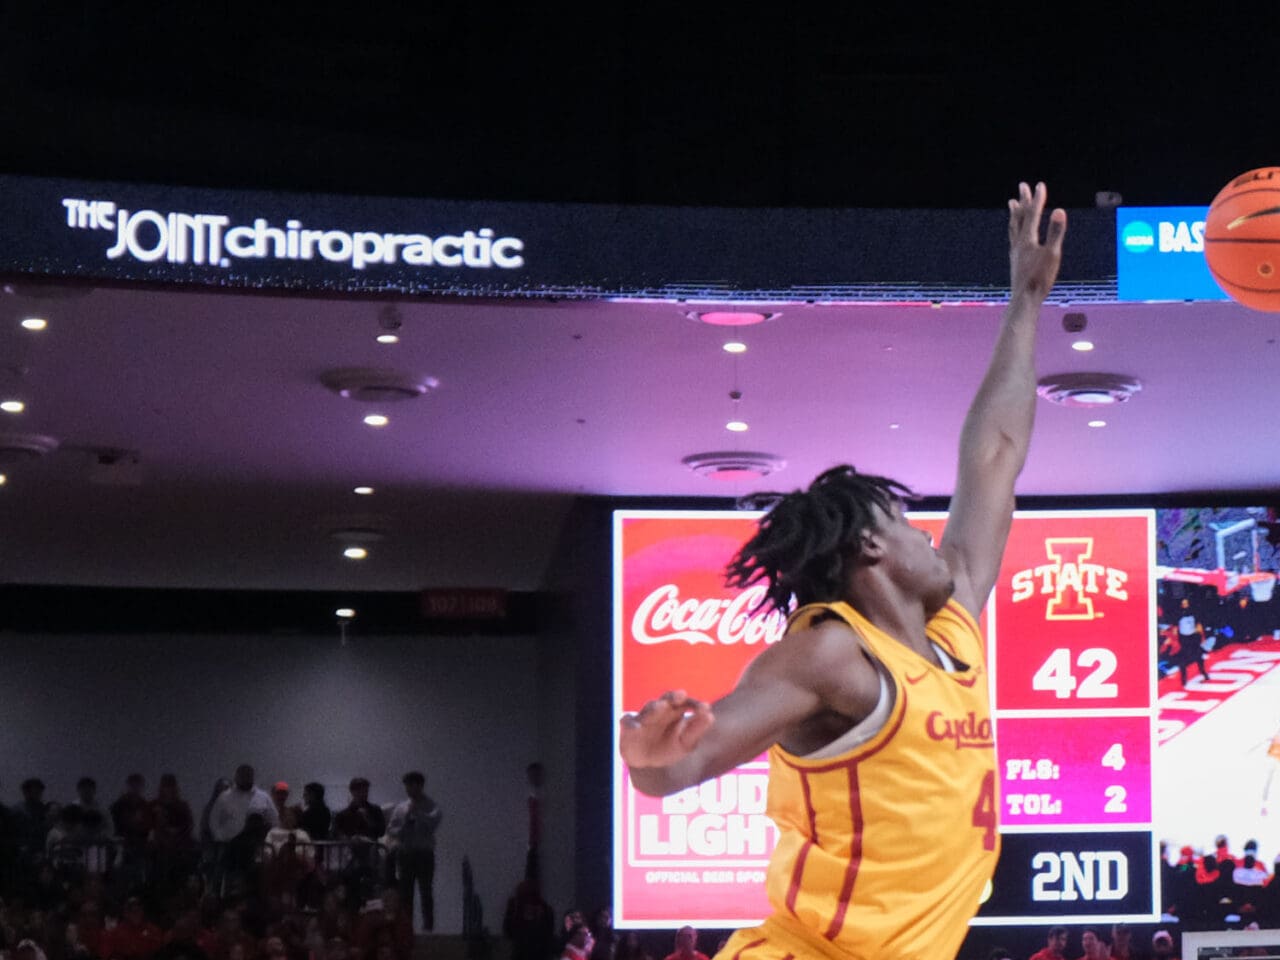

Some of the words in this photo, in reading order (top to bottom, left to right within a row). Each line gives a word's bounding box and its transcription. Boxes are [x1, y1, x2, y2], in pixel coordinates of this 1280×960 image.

[62, 198, 115, 230] THE
[224, 219, 525, 269] chiropractic
[1011, 563, 1129, 603] STATE
[1032, 647, 1119, 699] 42
[1006, 758, 1060, 780] FLS:
[1101, 743, 1126, 771] 4
[972, 769, 996, 851] 4
[1006, 794, 1062, 815] TOL:
[1104, 785, 1127, 813] 2
[1031, 851, 1129, 902] 2ND
